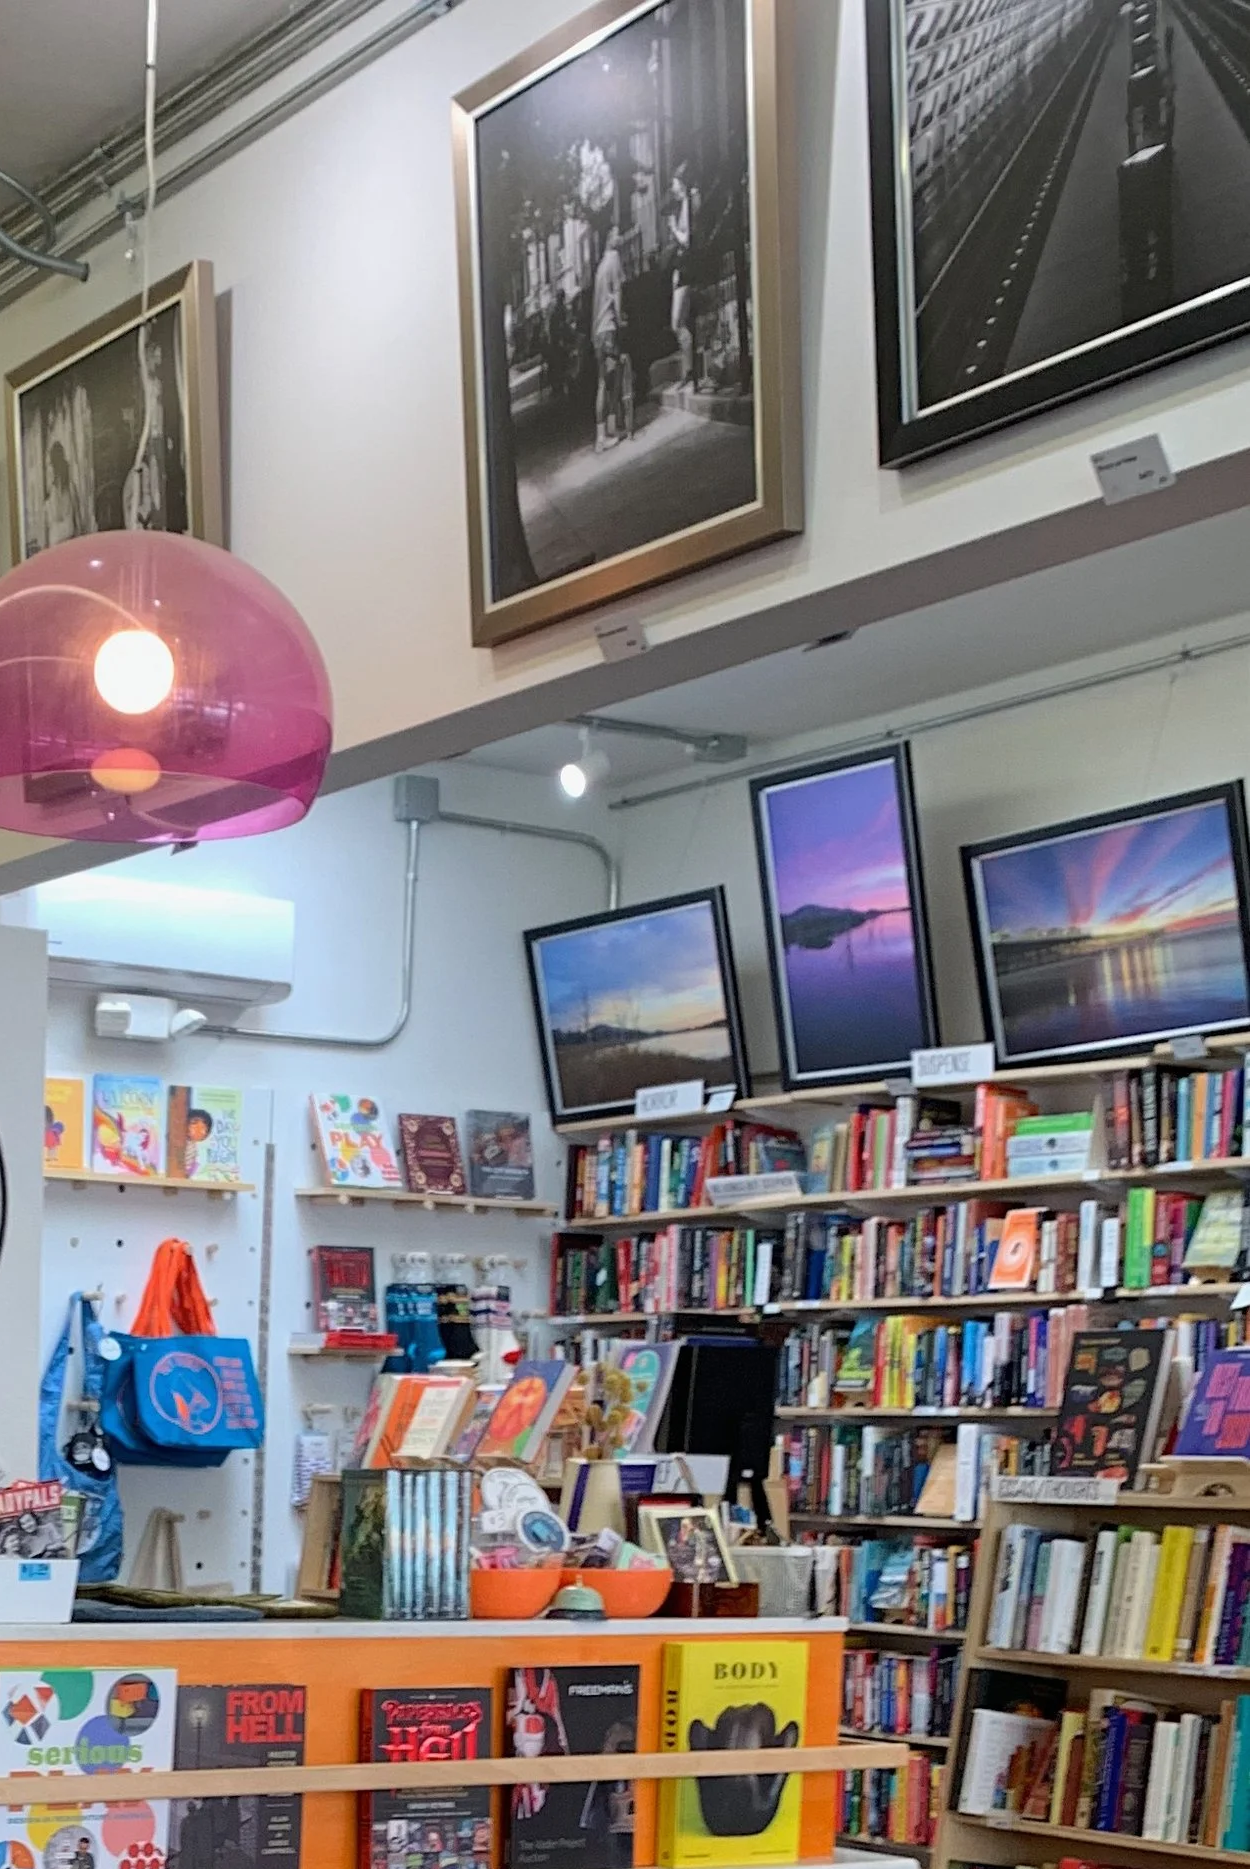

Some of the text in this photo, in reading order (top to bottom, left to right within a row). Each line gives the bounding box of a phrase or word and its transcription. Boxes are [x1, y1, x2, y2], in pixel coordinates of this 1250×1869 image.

[329, 1131, 383, 1149] PLAY
[713, 1661, 779, 1680] BODY
[226, 1690, 304, 1715] FROM
[225, 1715, 304, 1744] HELL
[27, 1737, 144, 1766] serious
